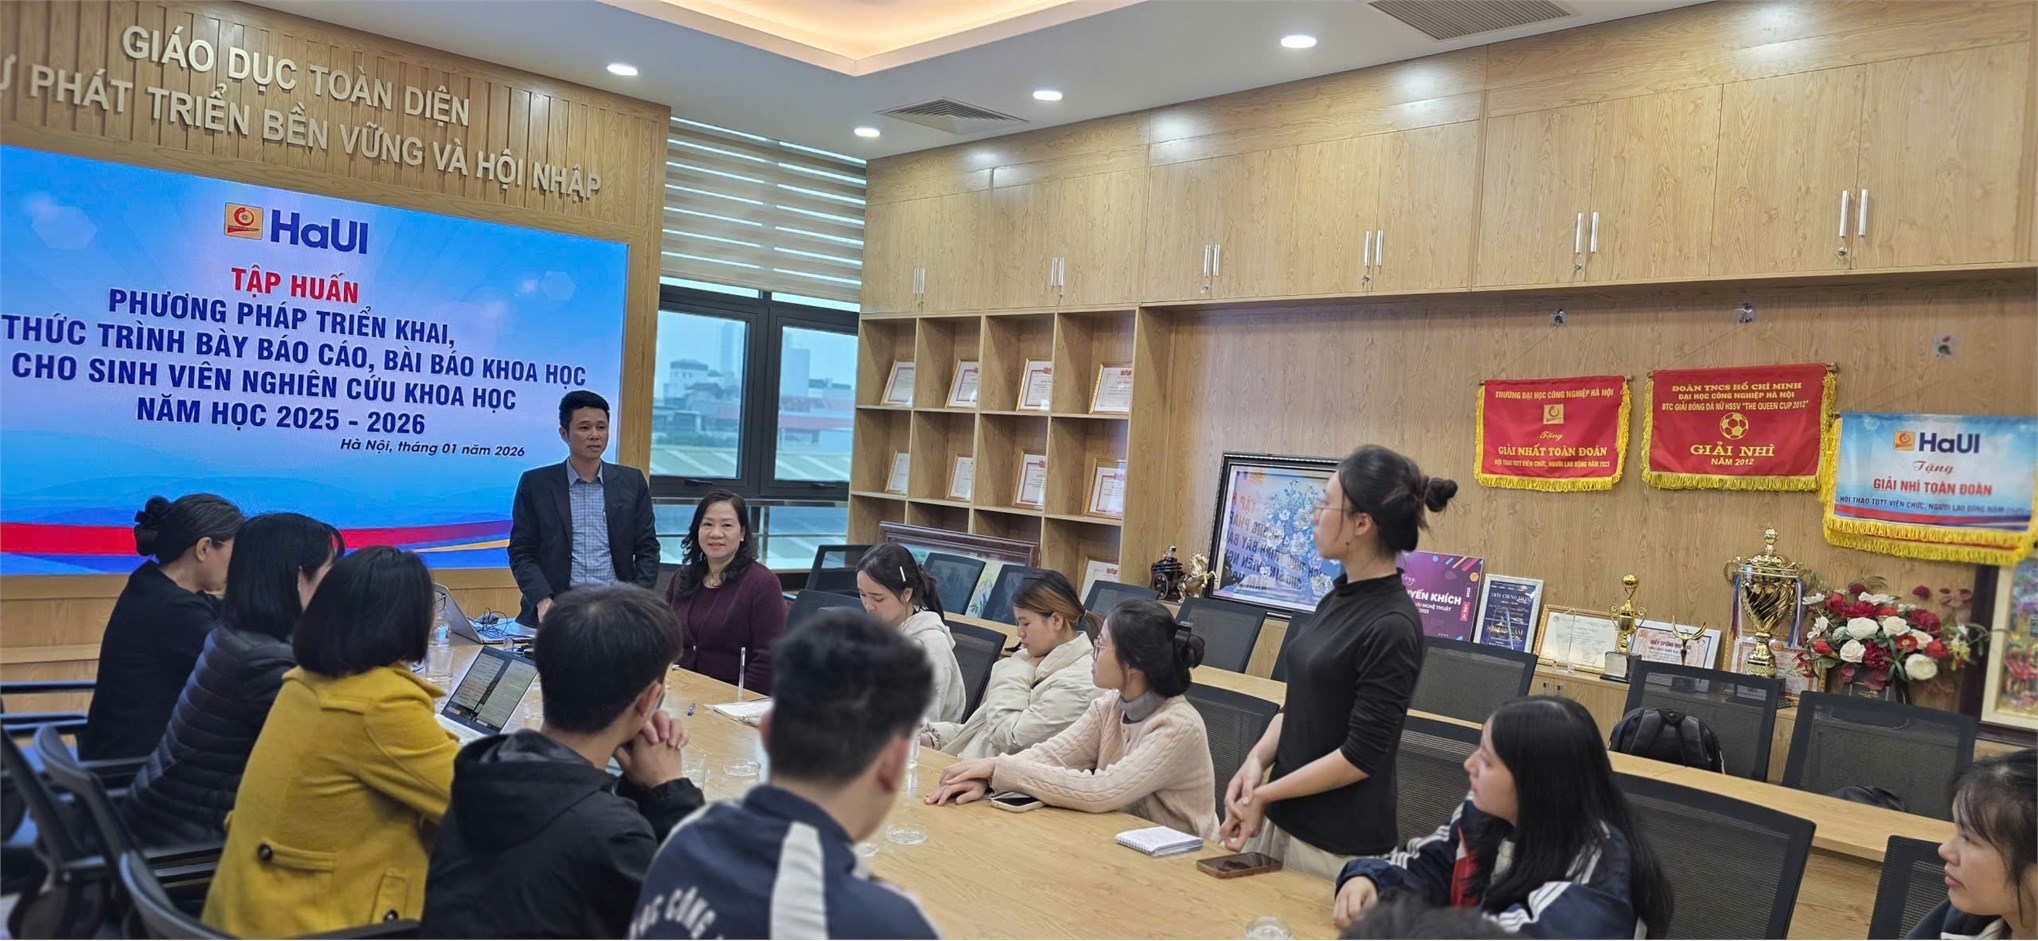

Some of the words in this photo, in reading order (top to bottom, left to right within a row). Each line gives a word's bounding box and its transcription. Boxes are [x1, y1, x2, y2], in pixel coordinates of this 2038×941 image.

[122, 25, 215, 72] GIÁO
[228, 46, 297, 92] DỤC
[309, 64, 392, 110] TOÀN
[404, 85, 470, 127] DIỆN
[30, 63, 133, 113] PHÁT
[147, 82, 250, 136] TRIỂN
[263, 101, 328, 150] BỀN
[340, 121, 424, 166] VỮNG
[433, 137, 468, 176] VÀ
[477, 148, 523, 189] HỘI
[533, 162, 601, 203] NHẬP
[270, 208, 368, 254] HaUI
[231, 264, 281, 298] TẬP
[291, 272, 358, 303] HUẤN
[109, 288, 227, 323] PHƯƠNG
[237, 300, 307, 330] PHÁP
[316, 305, 386, 338] TRIỂN
[395, 319, 455, 348] KHAI,
[1, 312, 86, 345] THỨC
[98, 320, 185, 353] TRÌNH
[196, 329, 249, 358] BÀY
[257, 334, 309, 363] BÁO
[318, 340, 375, 373] CÁO,
[384, 346, 421, 373] BÀI
[430, 350, 474, 377] BÁO
[482, 358, 538, 382] KHOA
[545, 364, 586, 390] HỌC
[12, 352, 77, 380] CHO
[89, 357, 157, 386] SINH
[169, 361, 231, 391] VIÊN
[242, 369, 337, 398] NGHIÊN
[346, 374, 396, 401] CỨU
[404, 382, 464, 406] KHOA
[472, 387, 516, 413] HỌC
[1752, 382, 1770, 390] CHÍ
[1773, 382, 1801, 390] MINH
[1547, 390, 1564, 399] CÔNG
[1566, 388, 1590, 399] NGHIỆP
[1601, 388, 1614, 398] NỘI
[1710, 391, 1732, 399] CÔNG
[1734, 391, 1764, 400] NGHIỆP
[1779, 391, 1794, 399] NỘI
[137, 393, 200, 423] NĂM
[211, 401, 267, 431] HỌC
[276, 406, 339, 430] 2025
[367, 411, 425, 434] 2026
[1725, 402, 1741, 410] HSSV
[1757, 402, 1778, 411] QUEEN
[1779, 402, 1792, 410] CUP
[340, 438, 361, 450] Hà
[365, 439, 392, 453] Nội,
[398, 441, 438, 456] tháng
[442, 443, 457, 455] 01
[461, 444, 490, 456] năm
[494, 445, 525, 457] 2026
[1498, 443, 1516, 456] GIẢI
[1517, 444, 1547, 456] NHẤT
[1690, 441, 1733, 456] GIẢI
[1739, 443, 1775, 457] NHÌ
[1918, 432, 1980, 453] HaUI
[1711, 457, 1733, 465] NĂM
[1912, 460, 1956, 475] Tặng
[1873, 476, 1896, 491] GIẢI
[1900, 478, 1920, 492] NHÌ
[1924, 480, 1956, 495] TOÀN
[1959, 482, 1992, 496] ĐOÀN
[1430, 593, 1462, 605] KHÍCH
